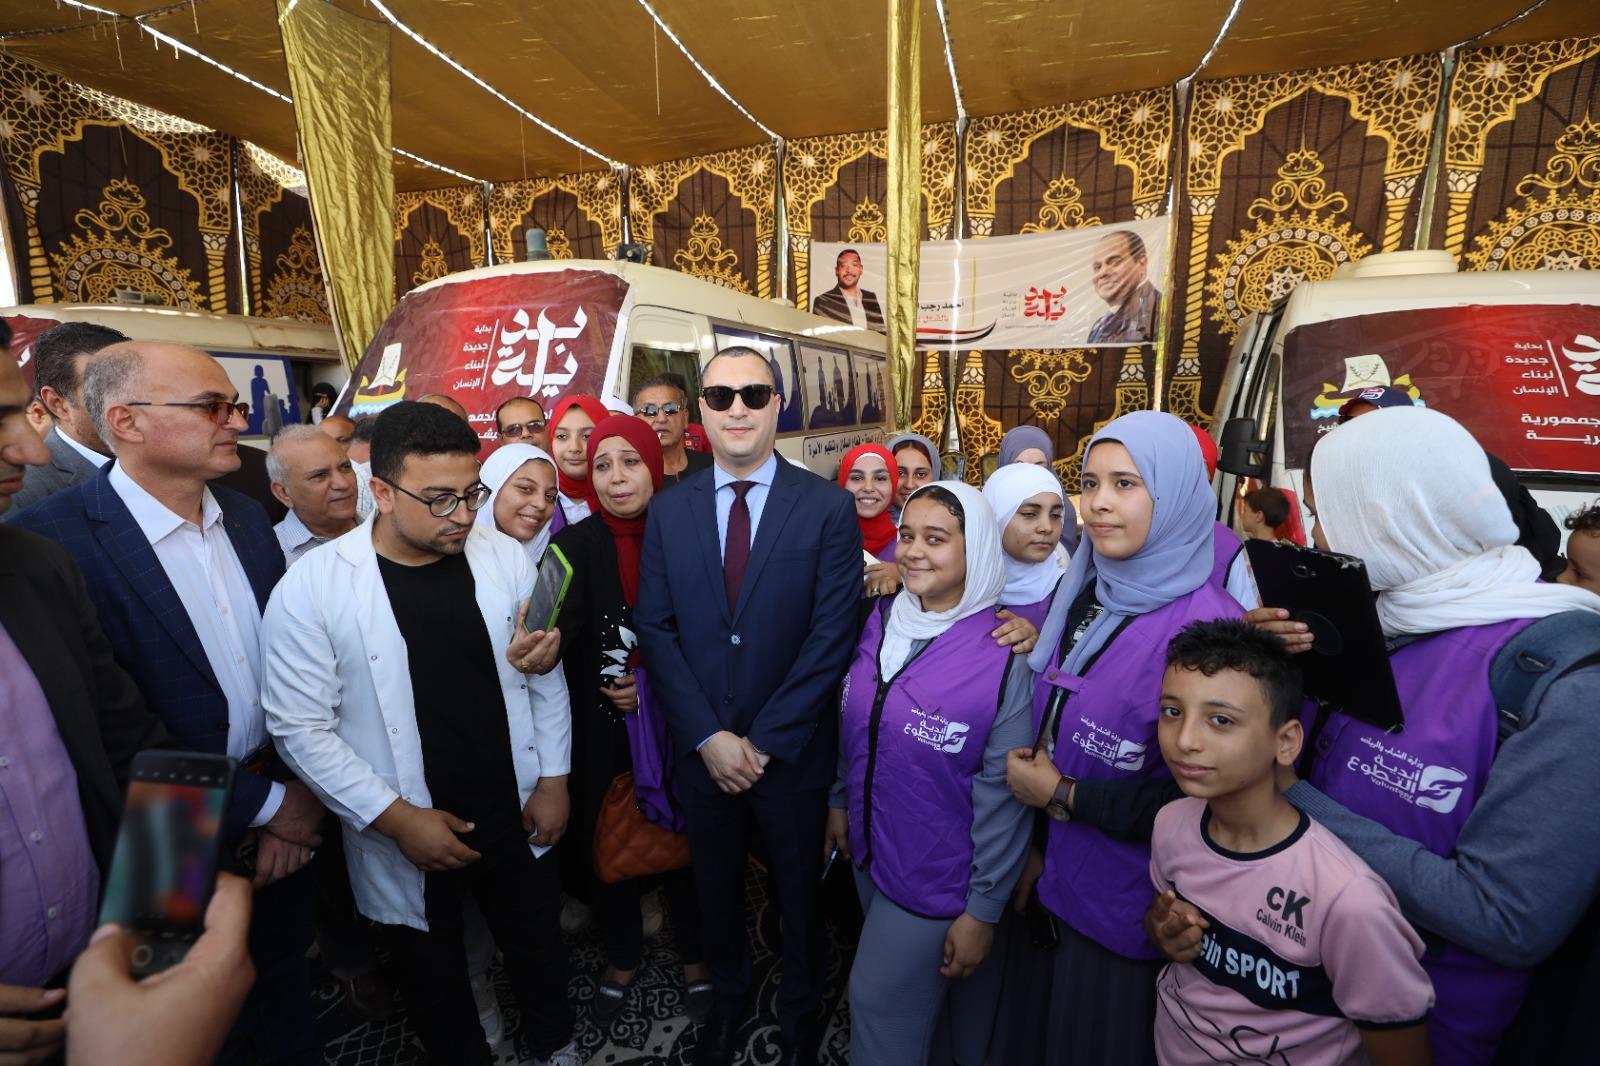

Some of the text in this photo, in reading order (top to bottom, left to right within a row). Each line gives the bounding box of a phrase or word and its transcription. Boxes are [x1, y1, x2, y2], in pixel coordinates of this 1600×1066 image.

[474, 324, 492, 333] بداية
[463, 342, 488, 352] جديدة
[1514, 342, 1543, 350] بداية
[464, 359, 485, 371] لبناء
[1505, 355, 1549, 364] جديدة
[1521, 370, 1554, 379] لبناء
[452, 377, 481, 390] الإنسان
[1512, 386, 1559, 396] الإنسان
[1521, 413, 1600, 427] جمهورية
[903, 723, 944, 743] التطوع
[1072, 732, 1116, 760] التطوع
[1347, 756, 1417, 794] التطوع
[1266, 886, 1311, 929] CK
[1256, 908, 1307, 947] Calvin Klein
[1200, 932, 1300, 999] ein SPORT
